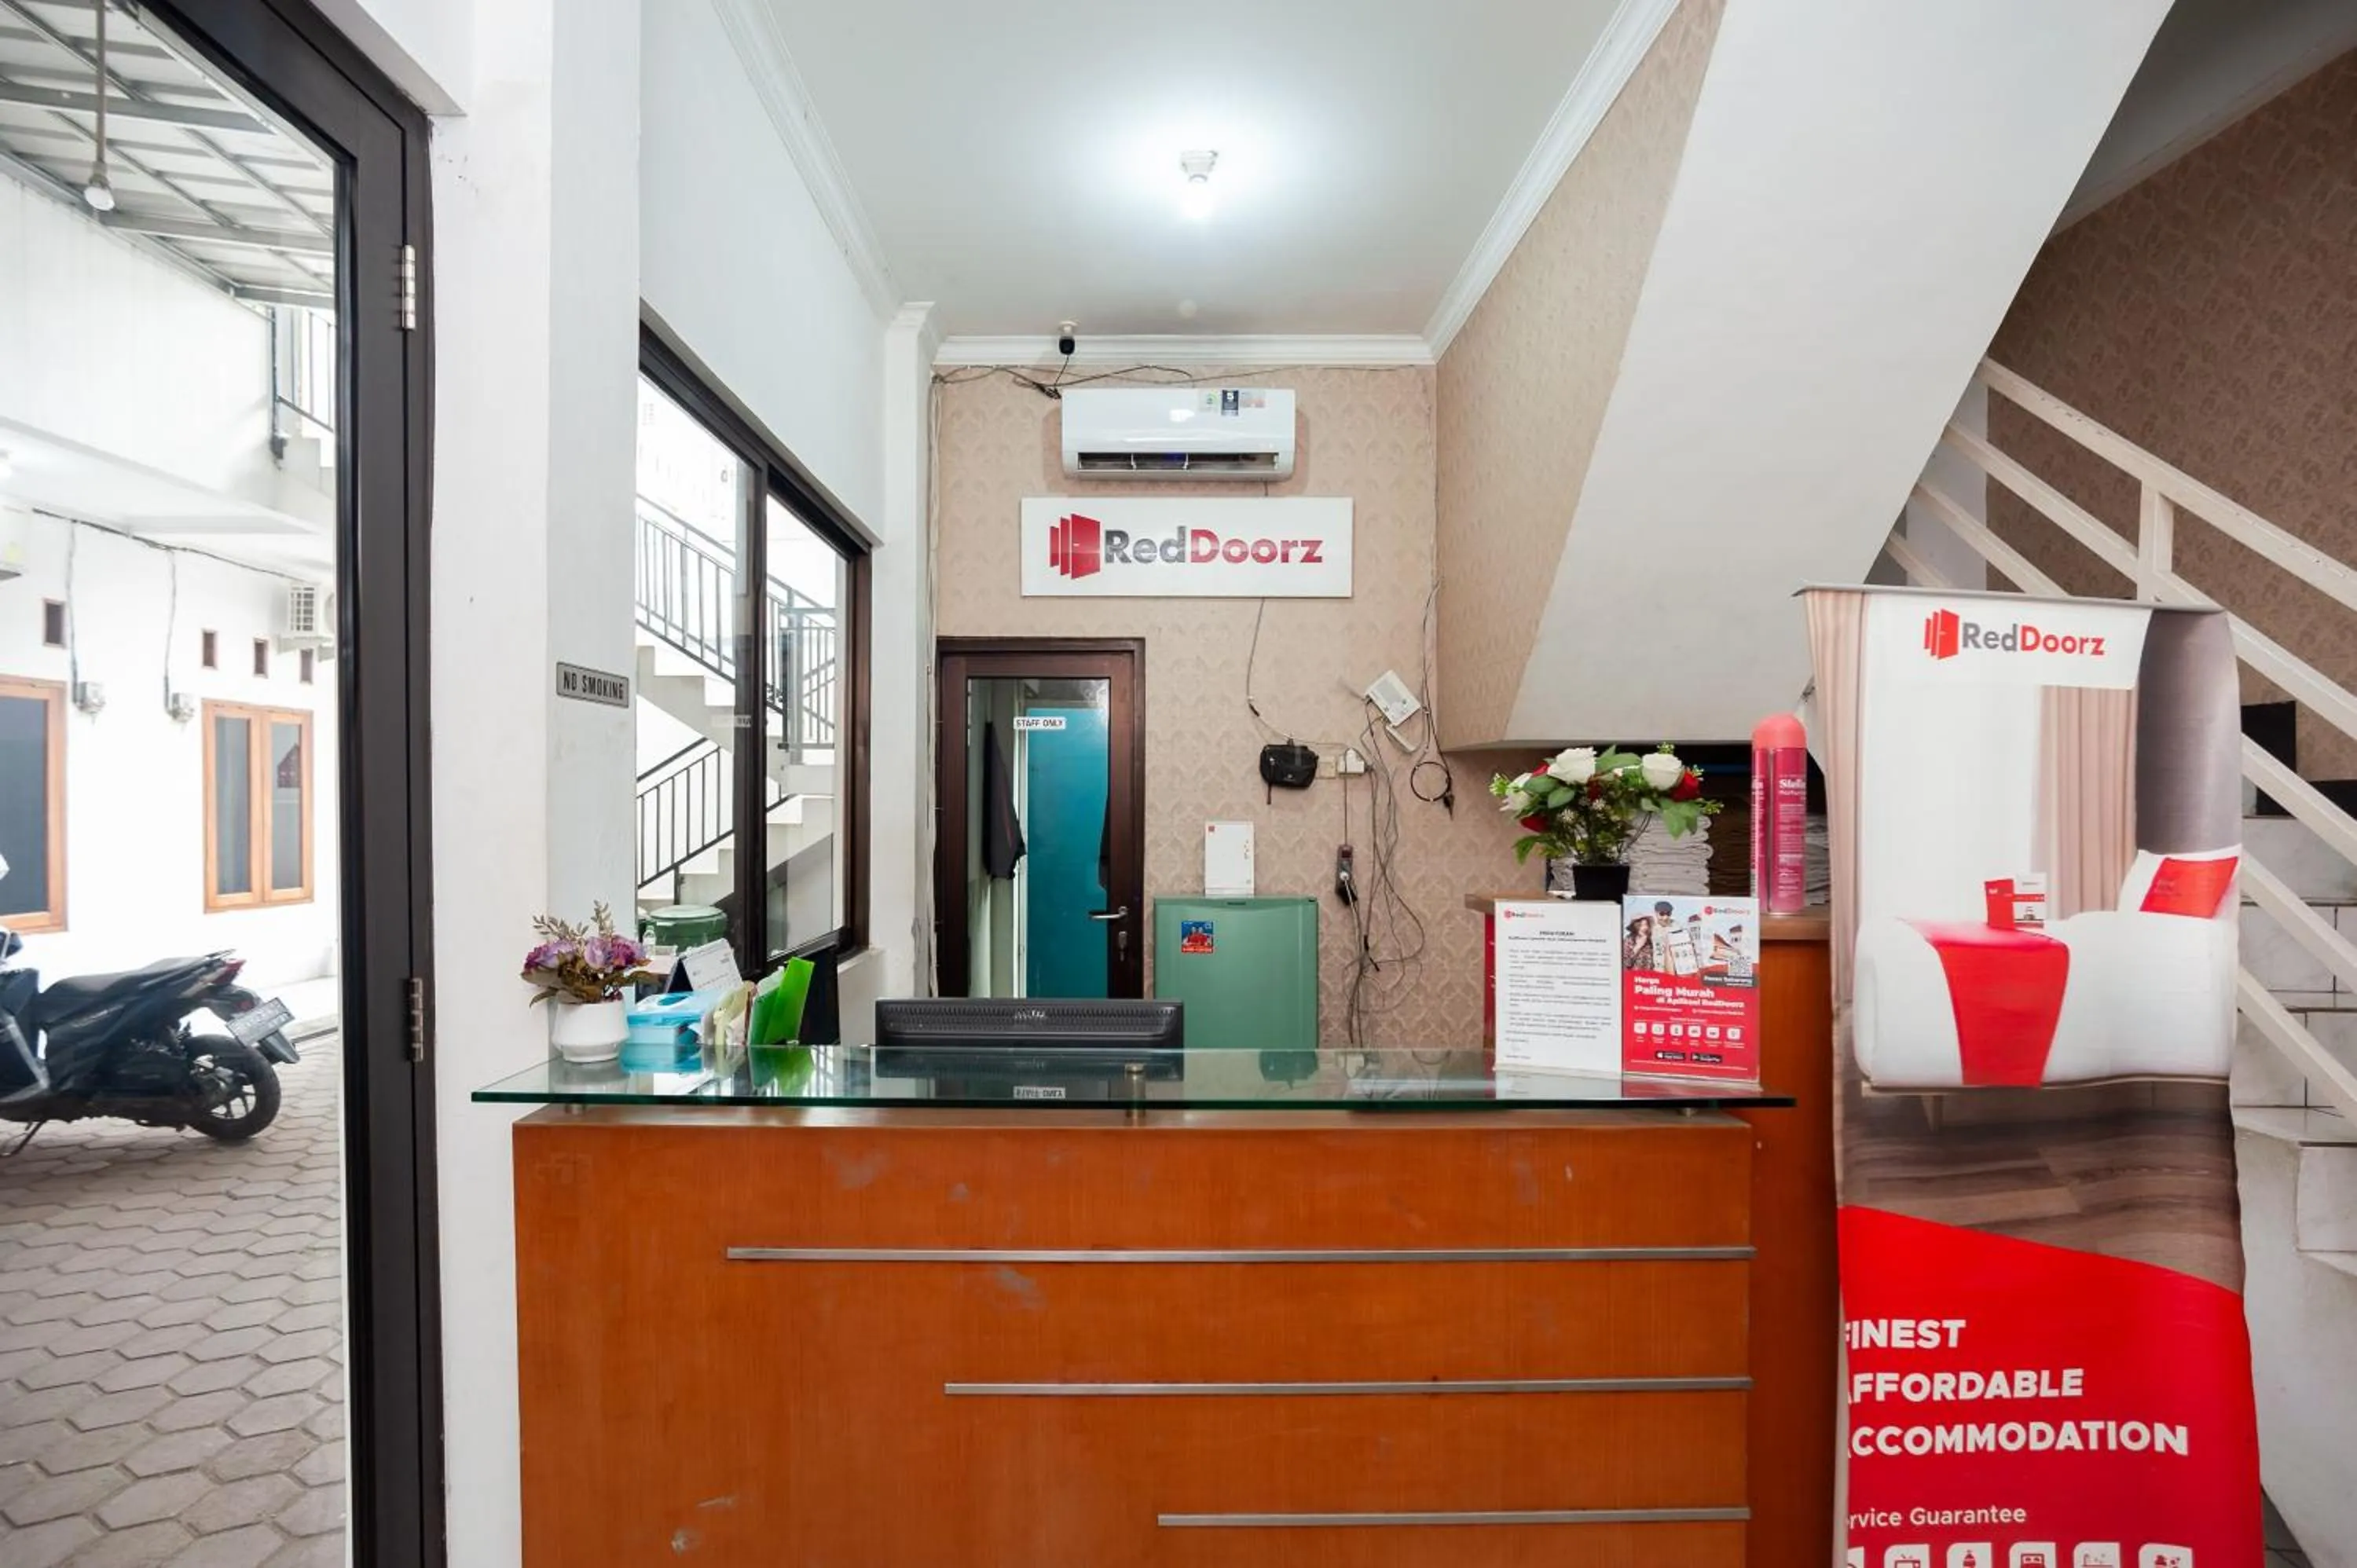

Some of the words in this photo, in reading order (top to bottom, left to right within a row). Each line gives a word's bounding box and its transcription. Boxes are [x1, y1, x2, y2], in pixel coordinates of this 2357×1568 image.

[1104, 525, 1323, 564] RedDoorz
[1962, 621, 2106, 657] RedDoorz
[563, 671, 577, 691] NO
[582, 675, 623, 699] SMOKING
[1016, 719, 1039, 727] STAFF
[1043, 719, 1063, 727] ONLY
[1634, 985, 1673, 997] Paling
[1675, 987, 1715, 998] Murah
[1847, 1368, 2084, 1404] FFORDABLE
[1847, 1421, 2189, 1458] CCOMMODATION
[1846, 1508, 1902, 1529] rvice
[1909, 1505, 2027, 1526] Guarantee
